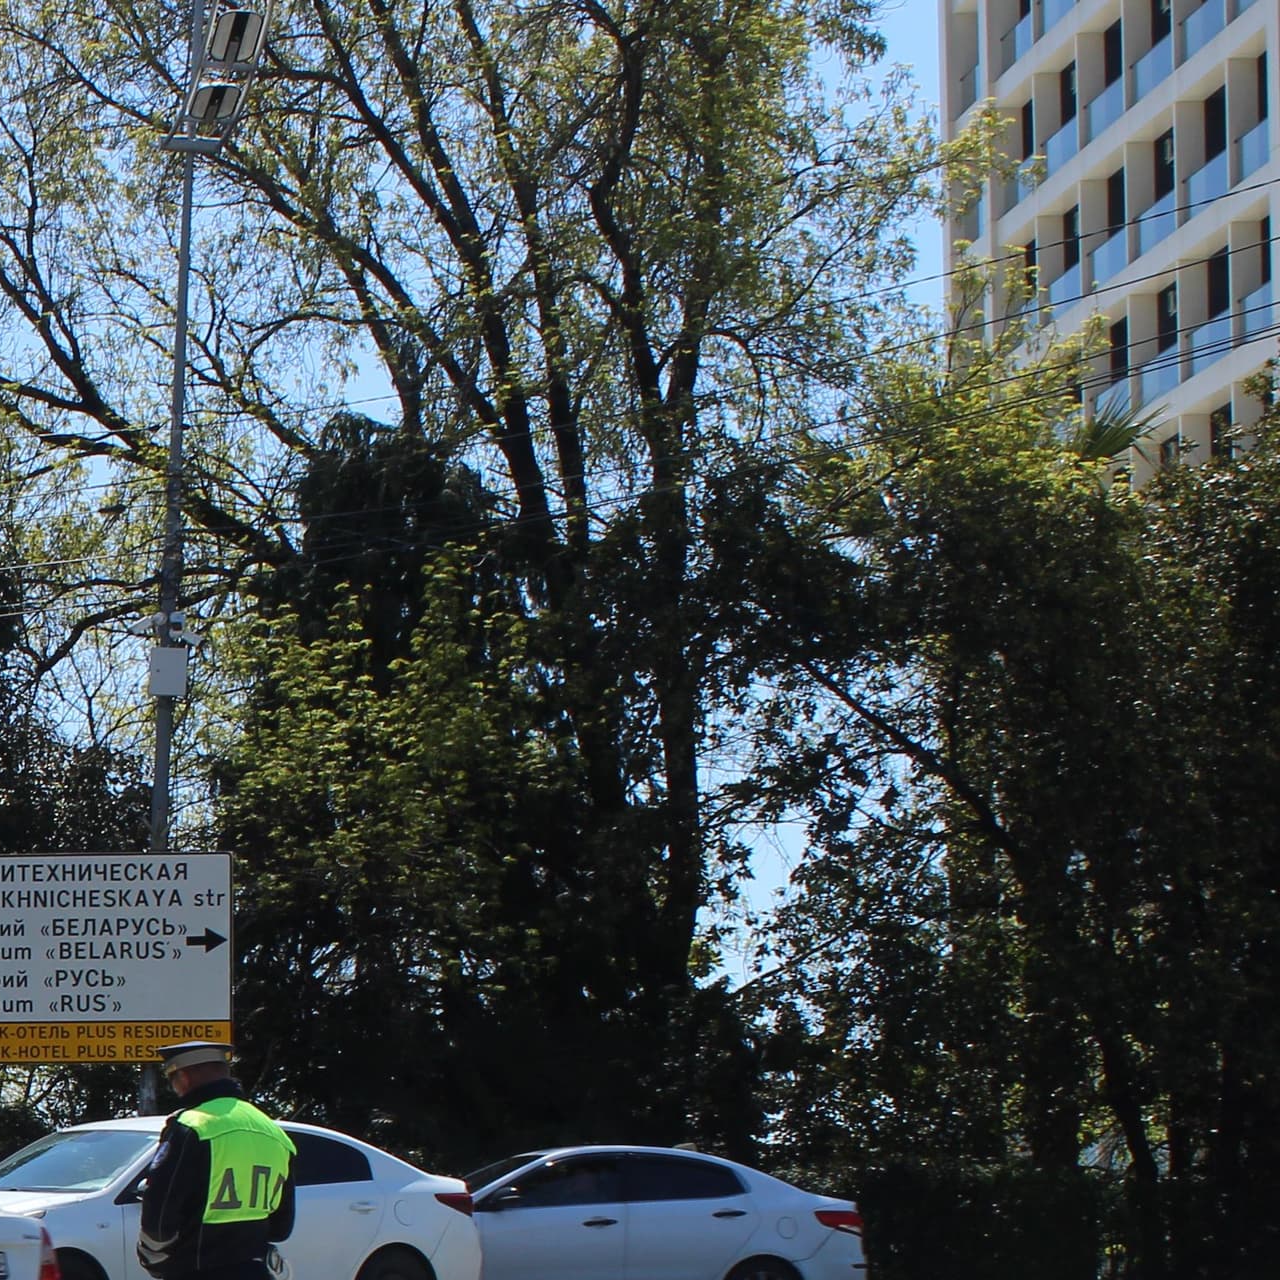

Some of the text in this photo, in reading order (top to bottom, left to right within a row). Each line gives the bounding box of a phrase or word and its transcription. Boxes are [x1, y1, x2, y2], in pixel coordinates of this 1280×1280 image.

[193, 889, 225, 907] str
[40, 918, 187, 937] «БЕЛАРУСЬ»
[44, 969, 126, 987] «РУСЬ»
[76, 1025, 116, 1039] PLUS
[123, 1024, 222, 1039] RESIDENCE»
[77, 1045, 116, 1058] PLUS
